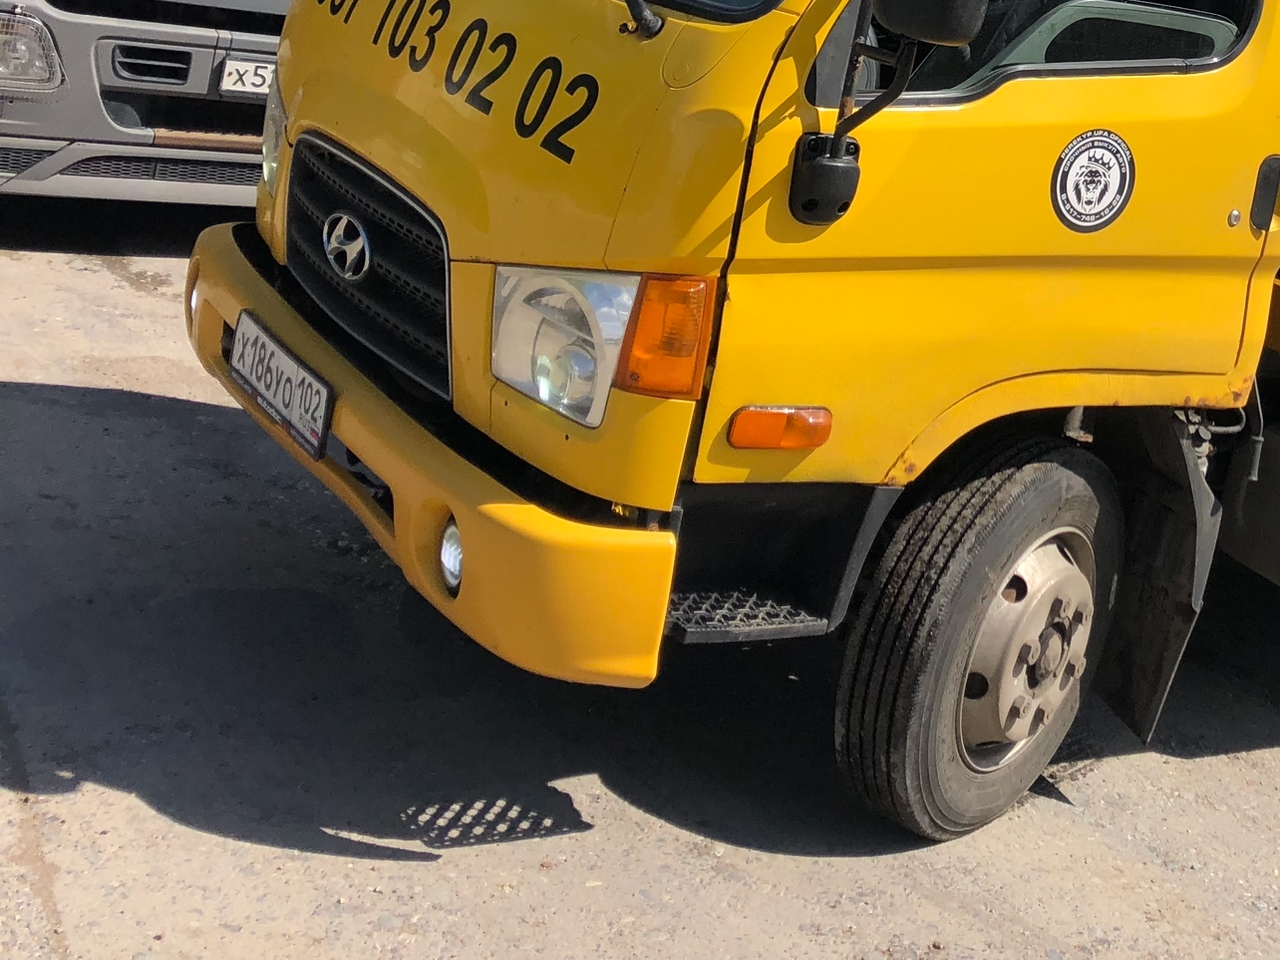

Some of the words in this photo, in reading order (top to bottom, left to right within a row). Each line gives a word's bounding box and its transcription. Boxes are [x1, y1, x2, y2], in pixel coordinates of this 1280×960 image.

[232, 65, 270, 88] Х5
[444, 17, 518, 115] 02
[515, 56, 600, 165] 02
[297, 376, 322, 423] 102
